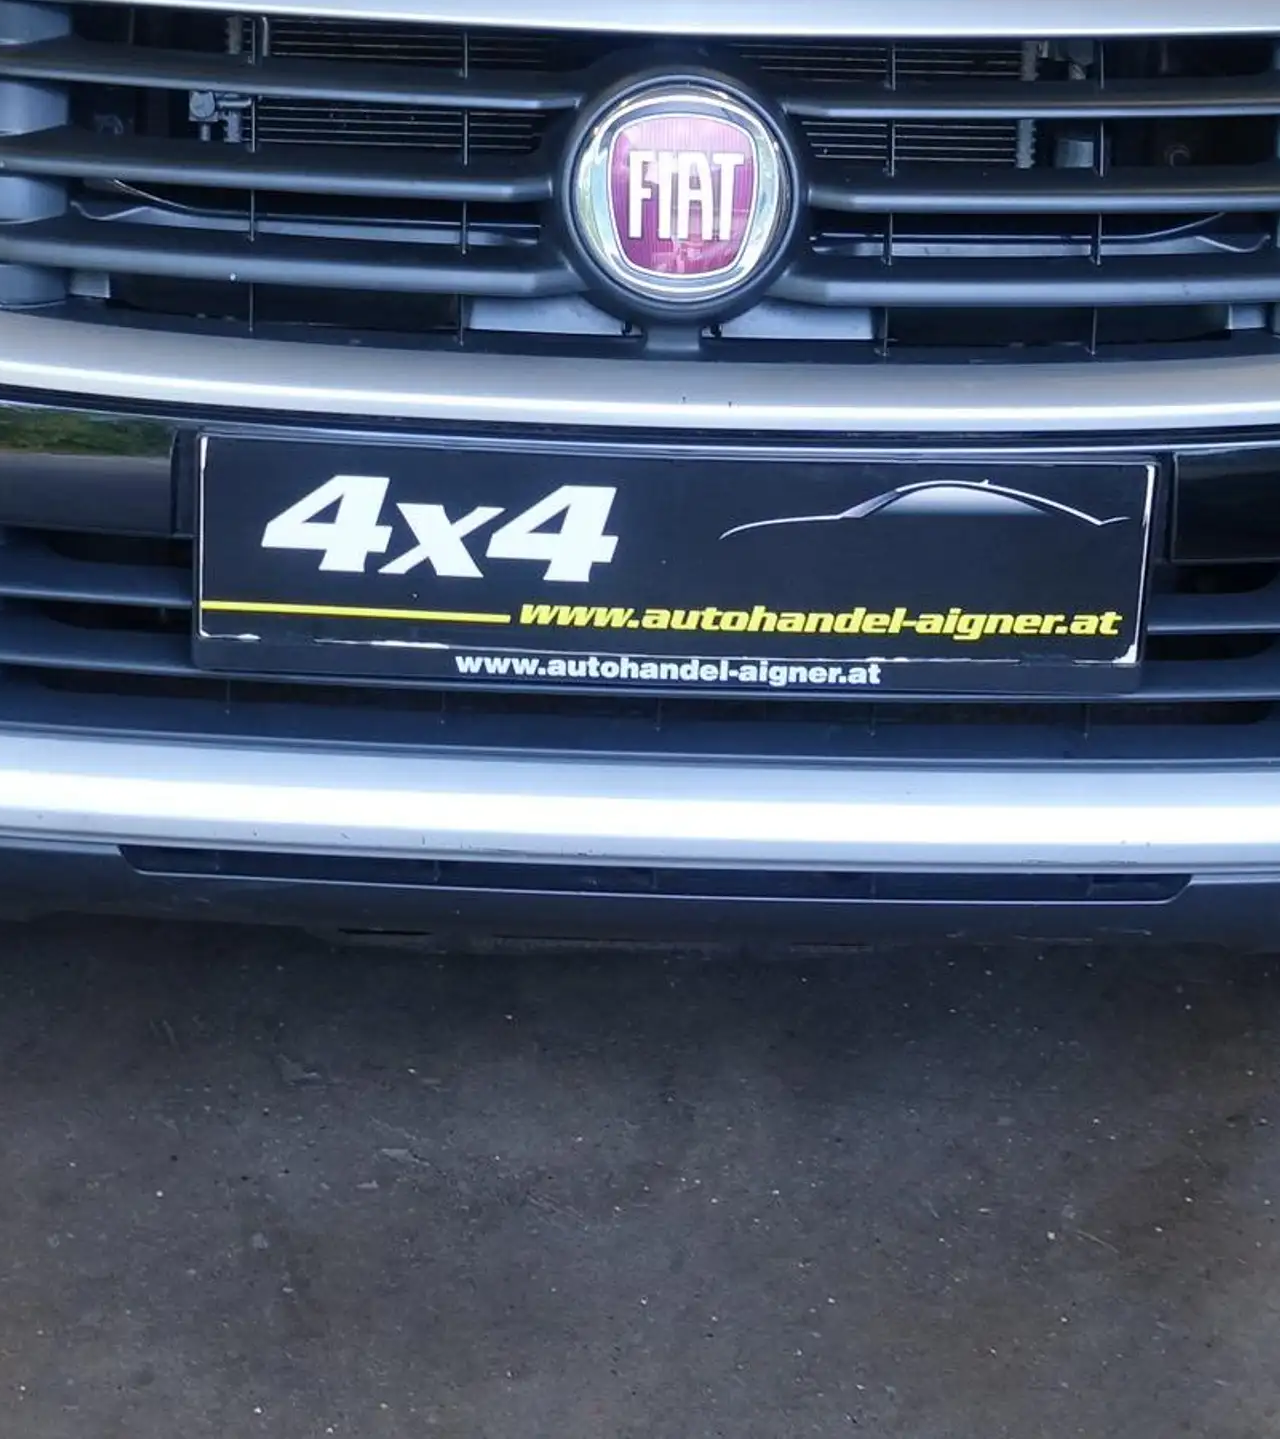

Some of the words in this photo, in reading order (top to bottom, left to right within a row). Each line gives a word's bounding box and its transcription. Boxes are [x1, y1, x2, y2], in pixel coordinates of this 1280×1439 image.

[629, 150, 745, 241] FIAT
[261, 474, 620, 584] 4x4
[519, 603, 1122, 641] www.autohandel-aigner.at
[455, 654, 882, 687] www.autohandel-aigner.at
